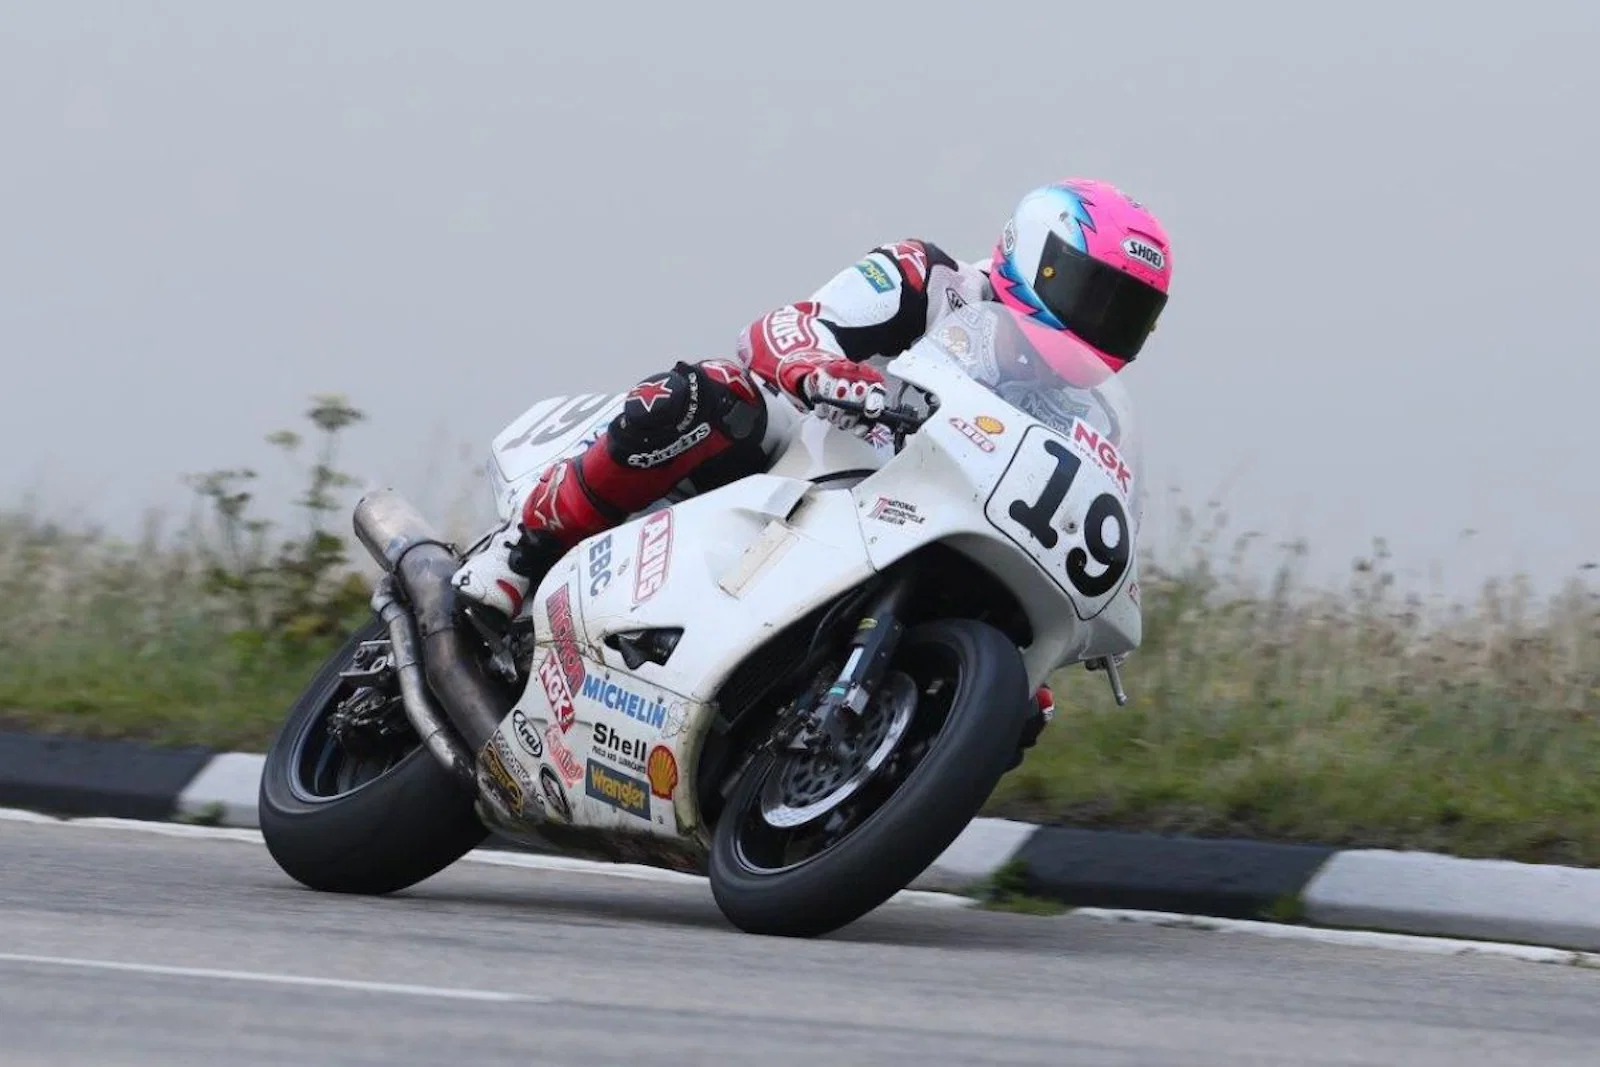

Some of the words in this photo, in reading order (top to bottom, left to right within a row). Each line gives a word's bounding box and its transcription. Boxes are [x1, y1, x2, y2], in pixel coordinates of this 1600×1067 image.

[1129, 241, 1162, 268] SHOEI
[953, 418, 996, 453] ABUS
[1074, 421, 1132, 494] NGK
[1009, 439, 1129, 598] 19
[589, 534, 613, 597] EBC
[636, 514, 670, 601] ABUS
[541, 663, 571, 724] NGK
[582, 674, 667, 729] MICHELIN
[514, 716, 542, 754] Arai
[593, 721, 648, 761] Shell
[590, 762, 647, 812] Wrangler
